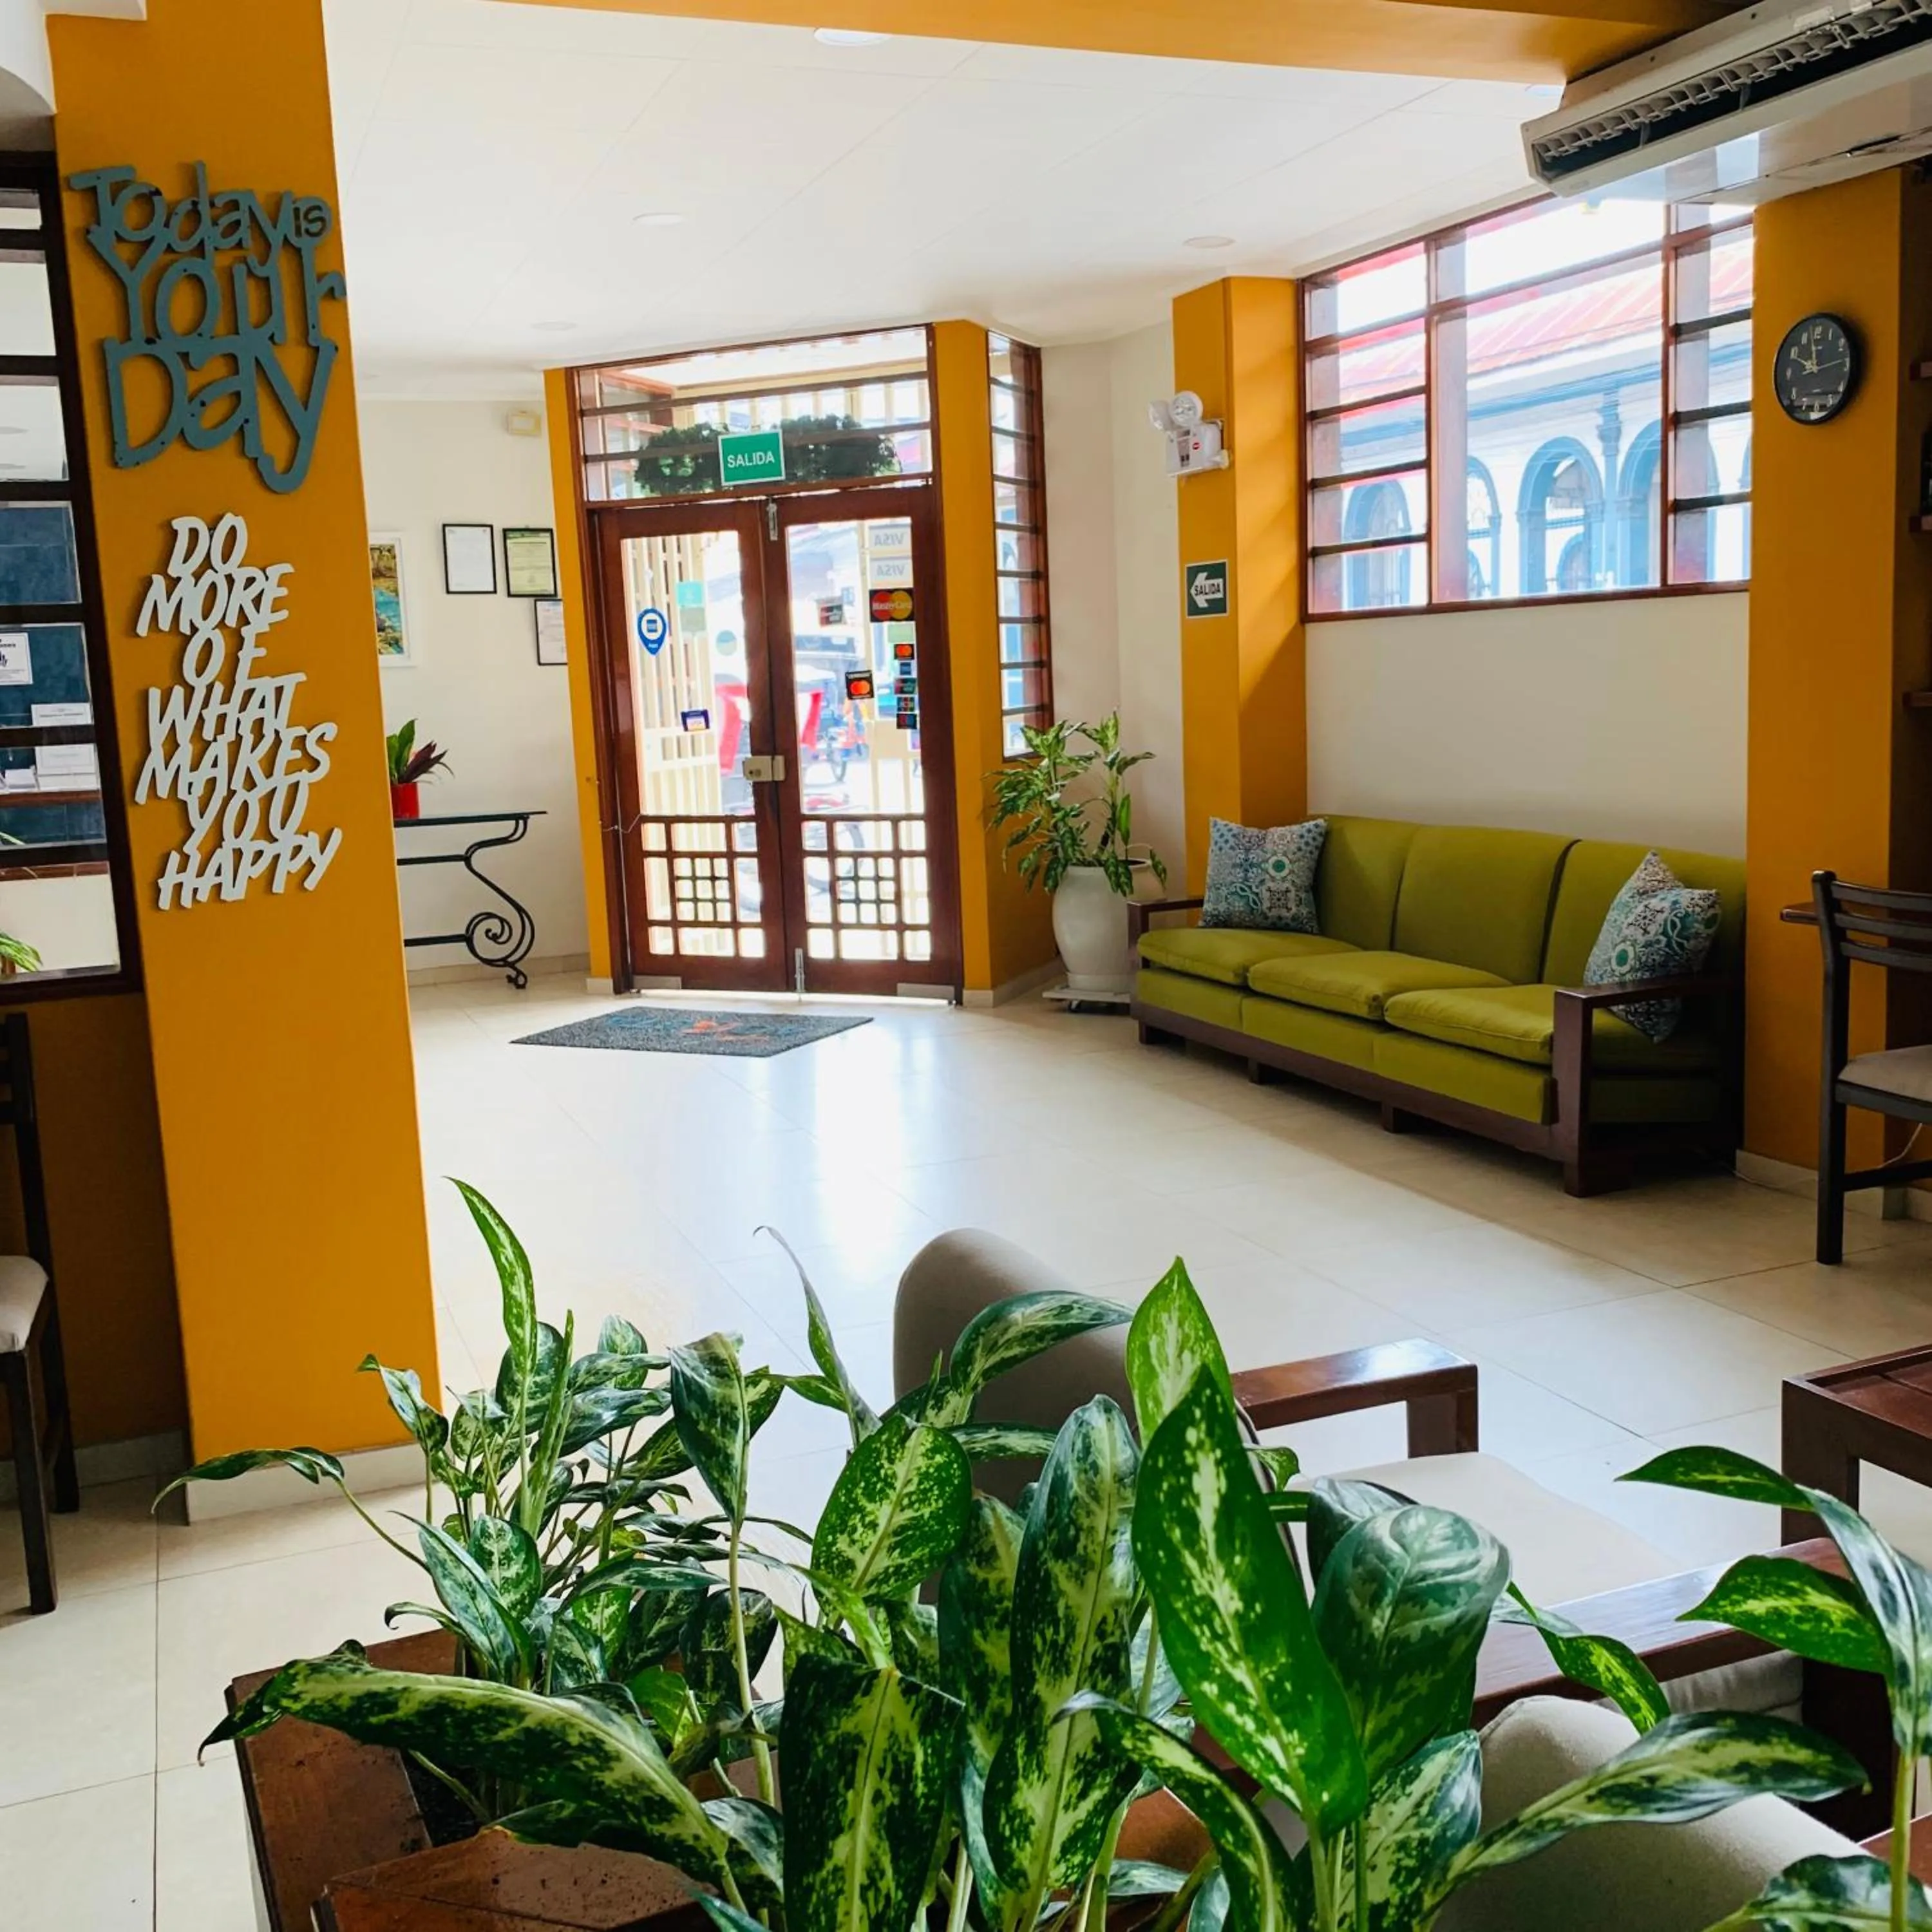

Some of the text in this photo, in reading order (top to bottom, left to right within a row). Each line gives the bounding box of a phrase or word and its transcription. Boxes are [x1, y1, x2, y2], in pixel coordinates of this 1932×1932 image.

[68, 161, 294, 276] Today
[87, 225, 347, 348] Your
[1801, 332, 1808, 344] 11
[1813, 326, 1823, 339] 12
[1828, 328, 1833, 340] 1
[1838, 338, 1846, 350] 2
[1843, 358, 1850, 371] 3
[102, 337, 338, 494] Day
[1801, 398, 1808, 410] 7
[727, 450, 775, 468] SALIDA
[167, 512, 249, 578] DO
[136, 562, 295, 637] MORE
[1195, 582, 1221, 597] SALIDA
[182, 625, 270, 687] OF
[148, 672, 307, 745] WHAT
[135, 722, 338, 805] MAKES
[183, 770, 309, 855] YOU
[158, 827, 343, 910] HAPPY
